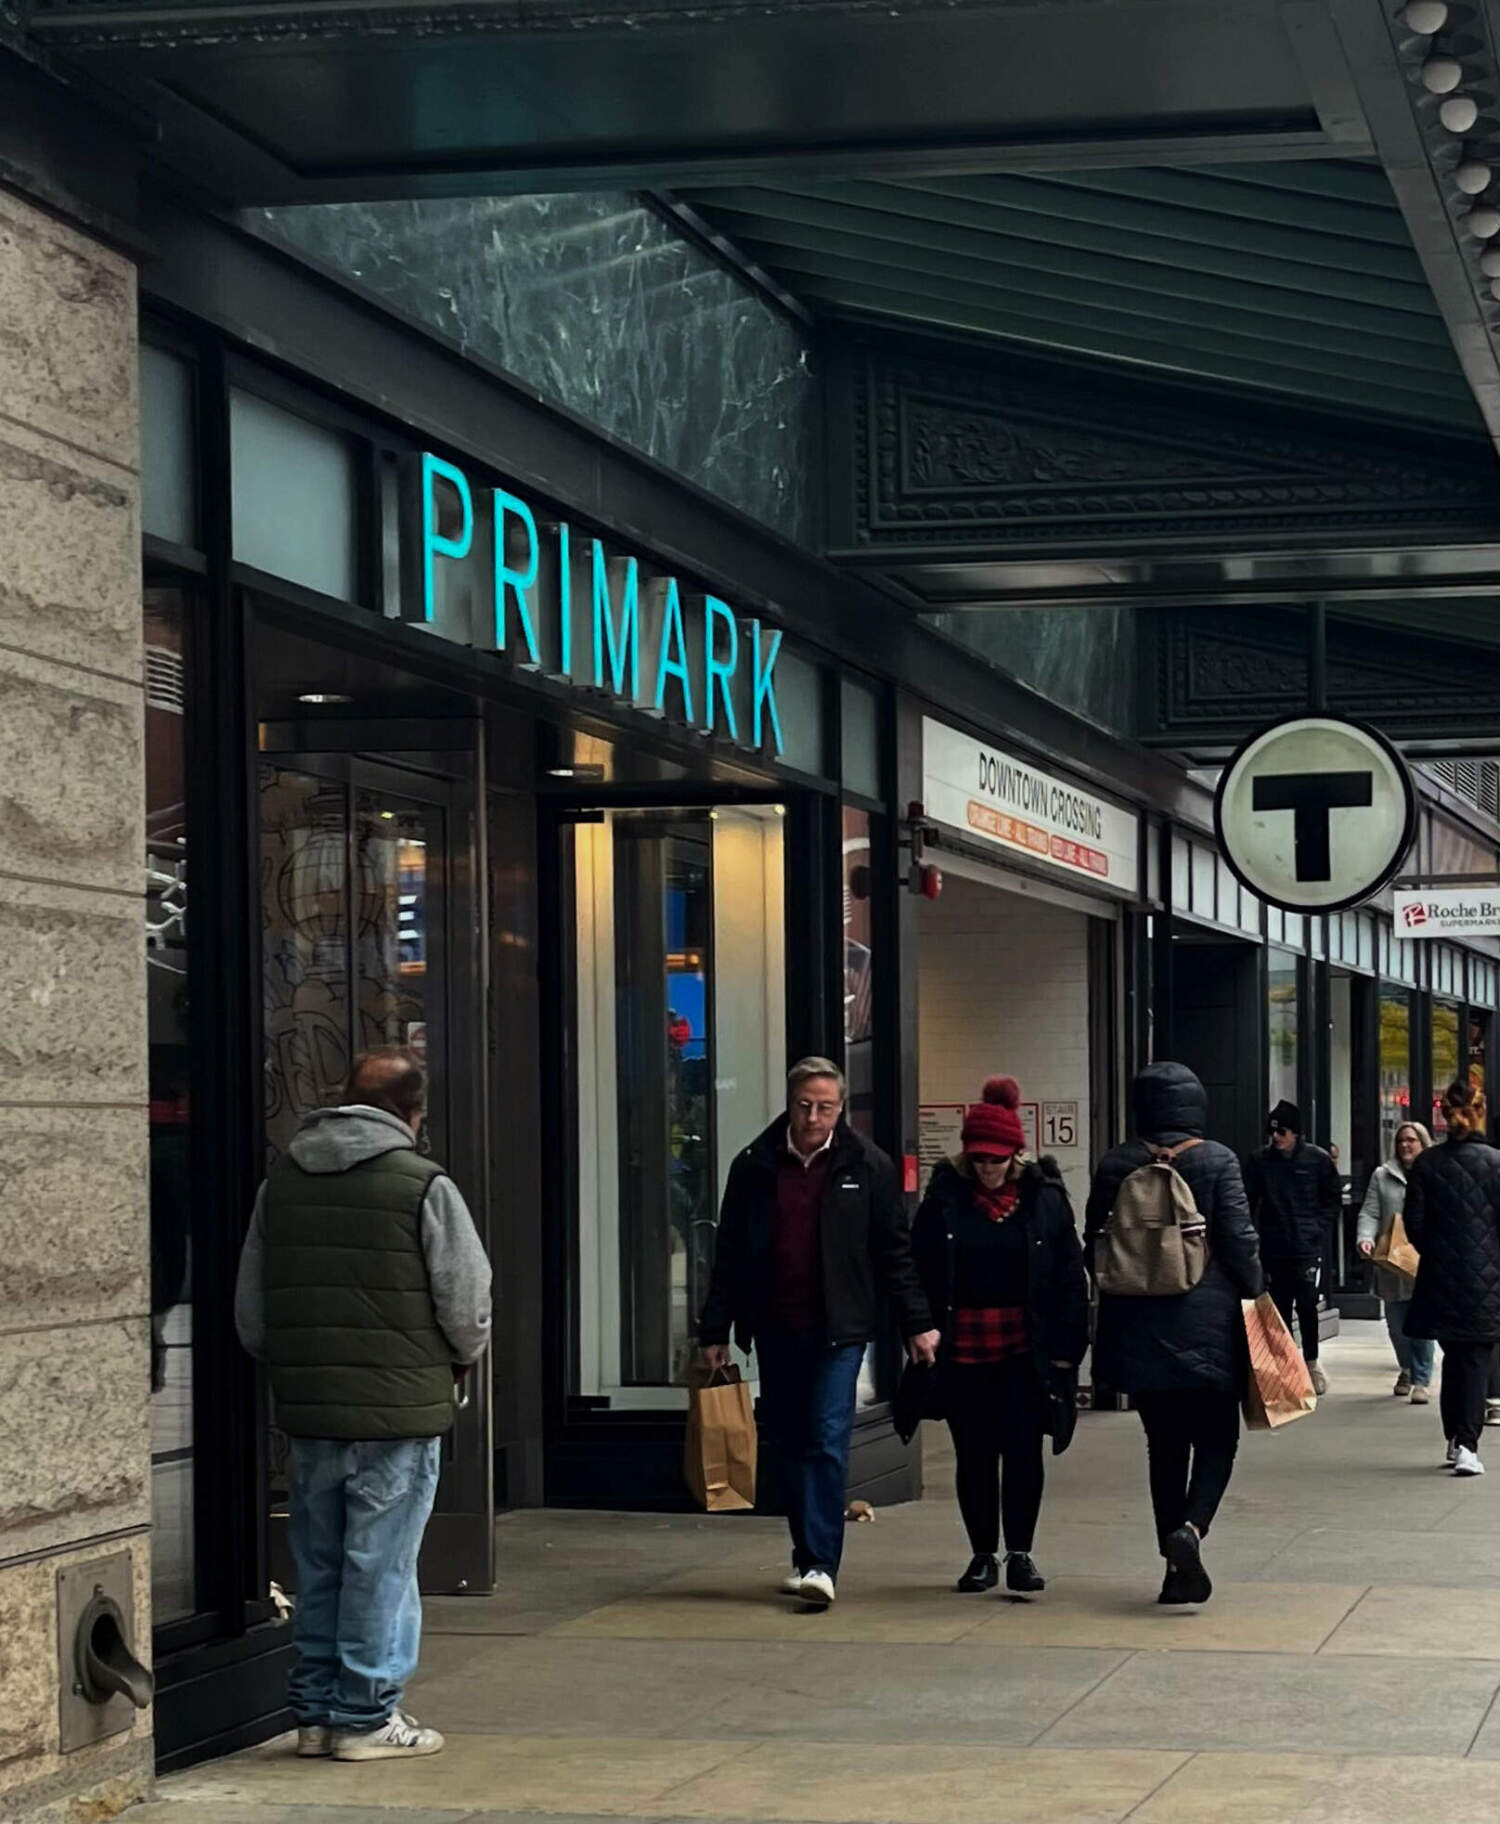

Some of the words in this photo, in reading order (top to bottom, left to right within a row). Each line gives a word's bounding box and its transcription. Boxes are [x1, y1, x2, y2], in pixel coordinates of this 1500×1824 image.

[421, 451, 784, 757] PRIMARK
[979, 752, 1048, 818] DOWNTOWN
[1050, 786, 1101, 839] CROSSING
[1252, 770, 1373, 883] T
[1428, 902, 1478, 918] Roche
[1047, 1116, 1073, 1144] 15
